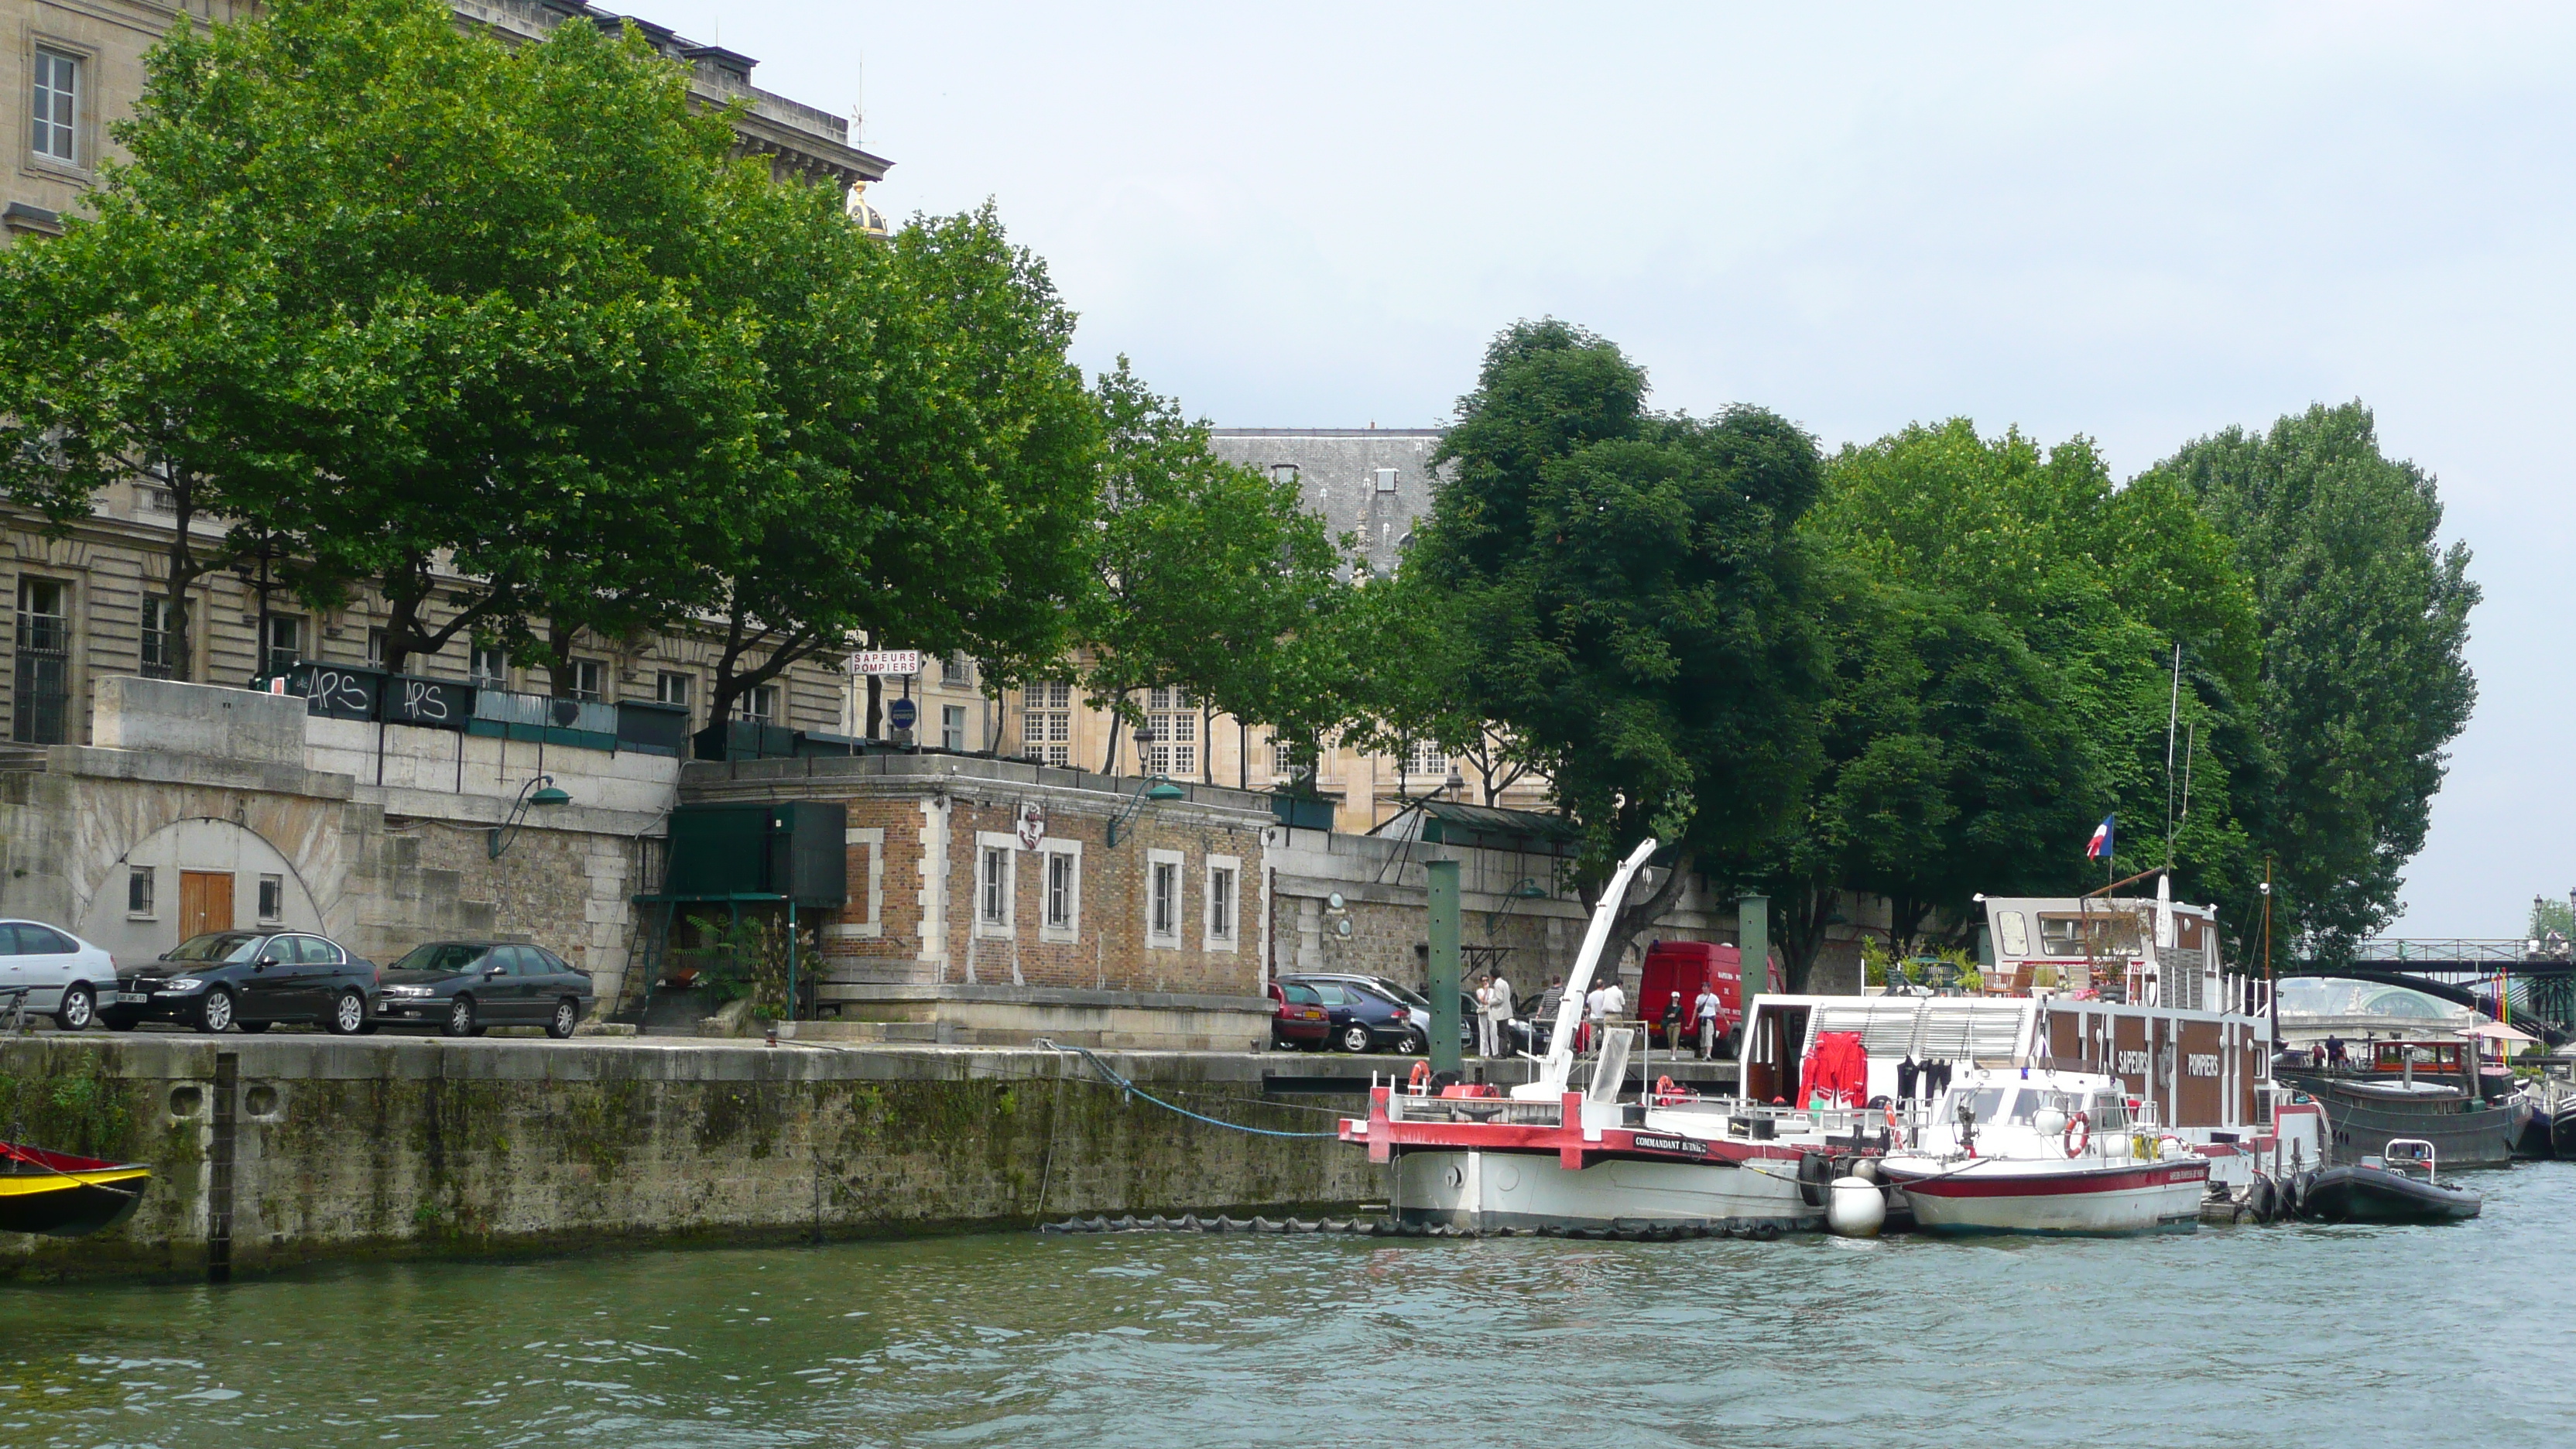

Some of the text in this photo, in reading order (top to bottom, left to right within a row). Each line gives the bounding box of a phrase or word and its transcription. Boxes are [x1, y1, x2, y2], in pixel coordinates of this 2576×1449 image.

[854, 653, 916, 663] SAPEURS
[854, 663, 916, 673] POMPIERS
[307, 666, 368, 711] APS
[404, 679, 447, 719] APS
[2118, 1050, 2218, 1077] SAPEURS POMPIERS
[1636, 1136, 1680, 1150] COMMANDANT
